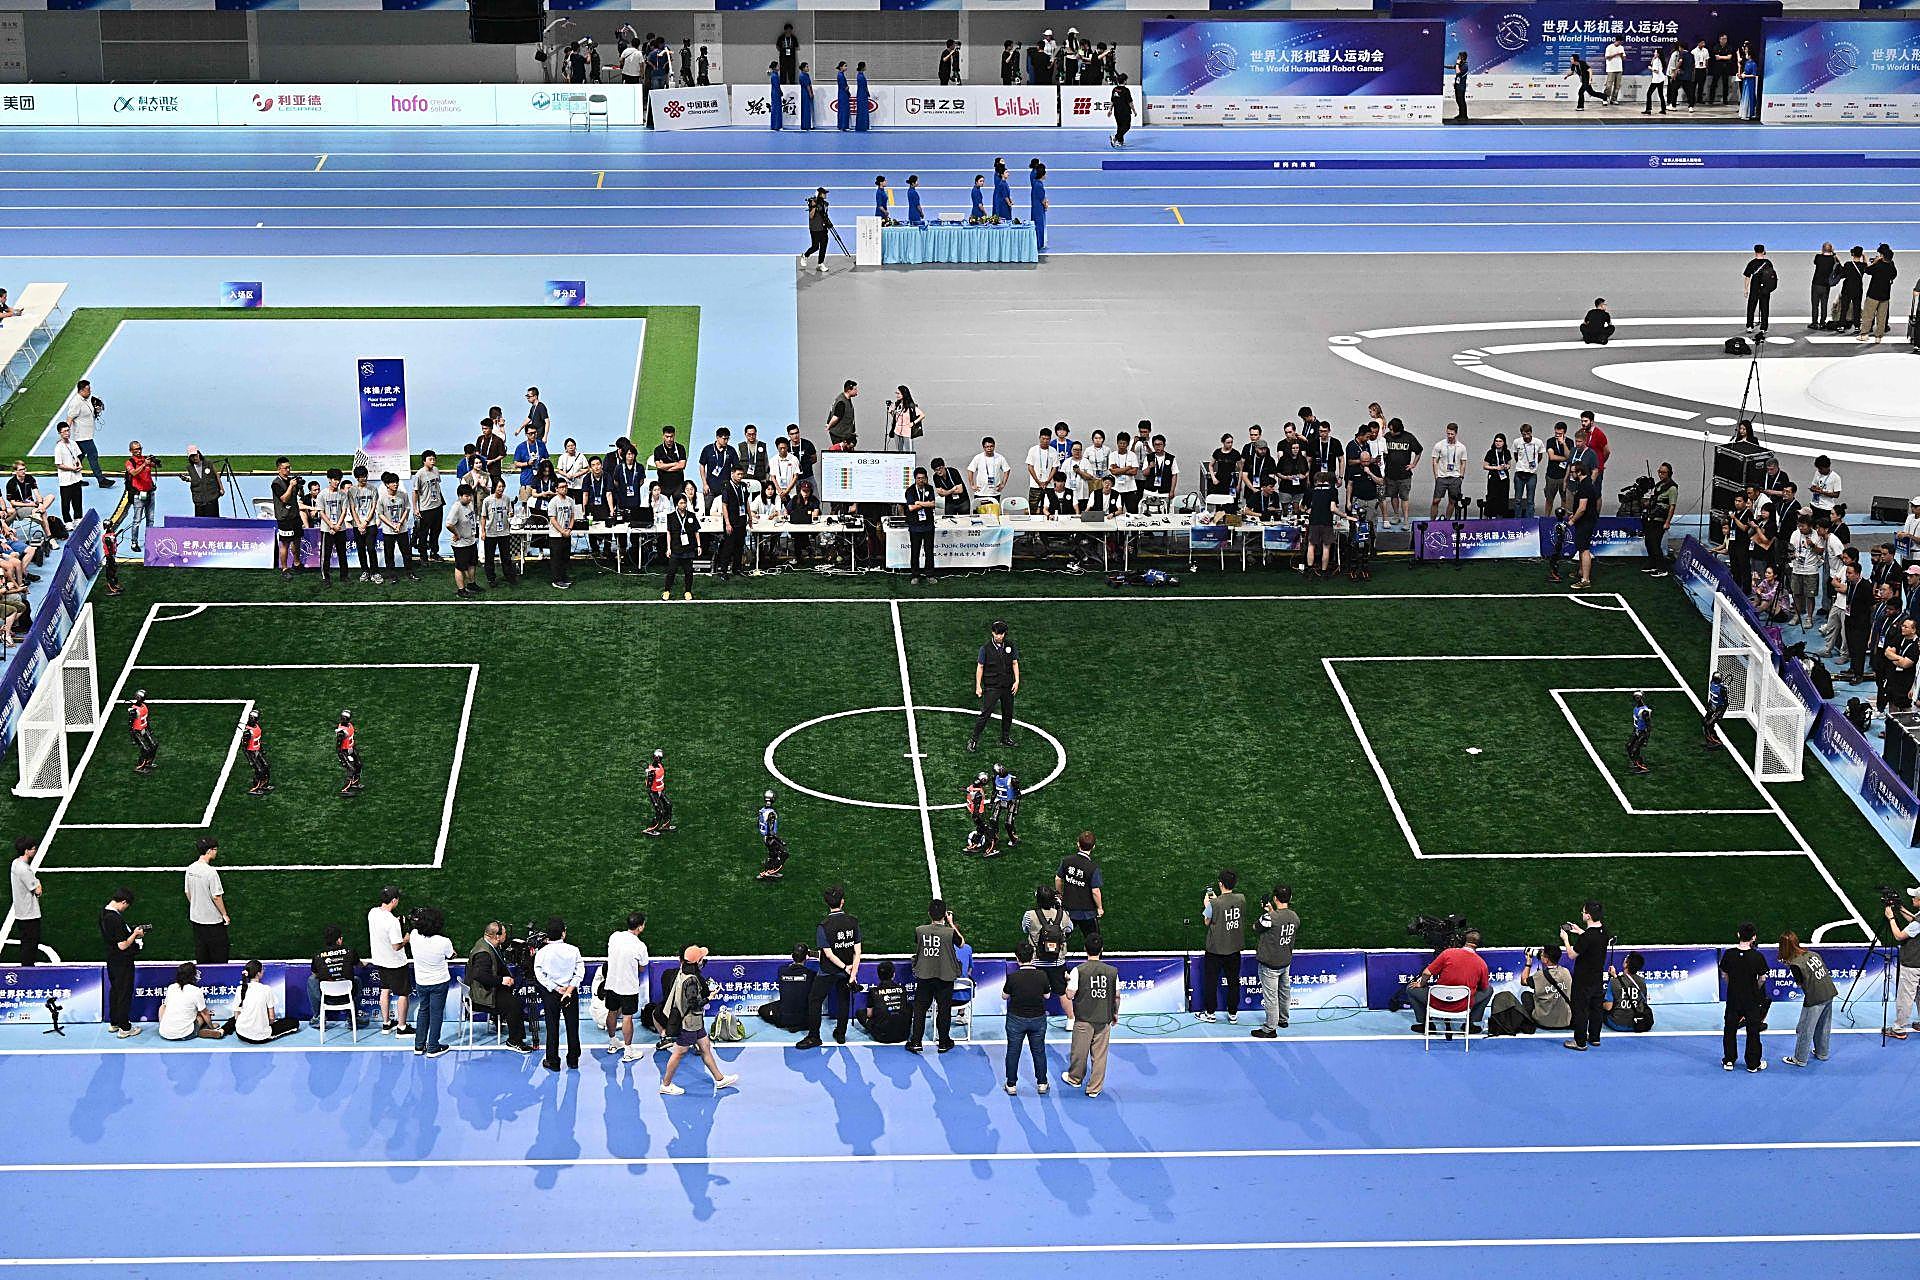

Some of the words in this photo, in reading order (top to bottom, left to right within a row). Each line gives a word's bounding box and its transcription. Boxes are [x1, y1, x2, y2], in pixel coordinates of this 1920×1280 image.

[1542, 20, 1679, 34] 世界人形机器人运动会
[1542, 35, 1557, 43] The
[1558, 35, 1582, 43] World
[1583, 35, 1616, 43] Humano
[1625, 35, 1649, 43] Robot
[1650, 35, 1678, 43] Games
[1251, 49, 1384, 63] 世界人形机器人运动会
[3, 95, 35, 111] 美团
[138, 96, 178, 105] 科大讯飞
[278, 94, 322, 106] 利亚德
[391, 94, 428, 112] hofo
[686, 100, 718, 109] 中国联通
[923, 98, 965, 110] 慧之安
[994, 96, 1040, 117] bilibili
[230, 290, 254, 299] 入场区
[363, 386, 401, 395] 体操/武术
[183, 540, 268, 550] 世界人形机器人运动会
[1067, 866, 1084, 879] 裁判
[1225, 907, 1241, 922] HB
[1226, 920, 1240, 931] 098
[1280, 923, 1295, 937] HB
[837, 929, 854, 940] 裁判
[834, 940, 855, 949] Referee
[922, 934, 941, 948] HB
[923, 947, 940, 957] 002
[1806, 956, 1823, 972] HB
[1090, 975, 1108, 989] HB
[1488, 972, 1514, 982] 大师赛
[0, 989, 72, 999] 世界杯北京大师赛
[724, 993, 746, 1002] Beijing
[1091, 988, 1107, 999] 053
[1621, 987, 1639, 1000] HB
